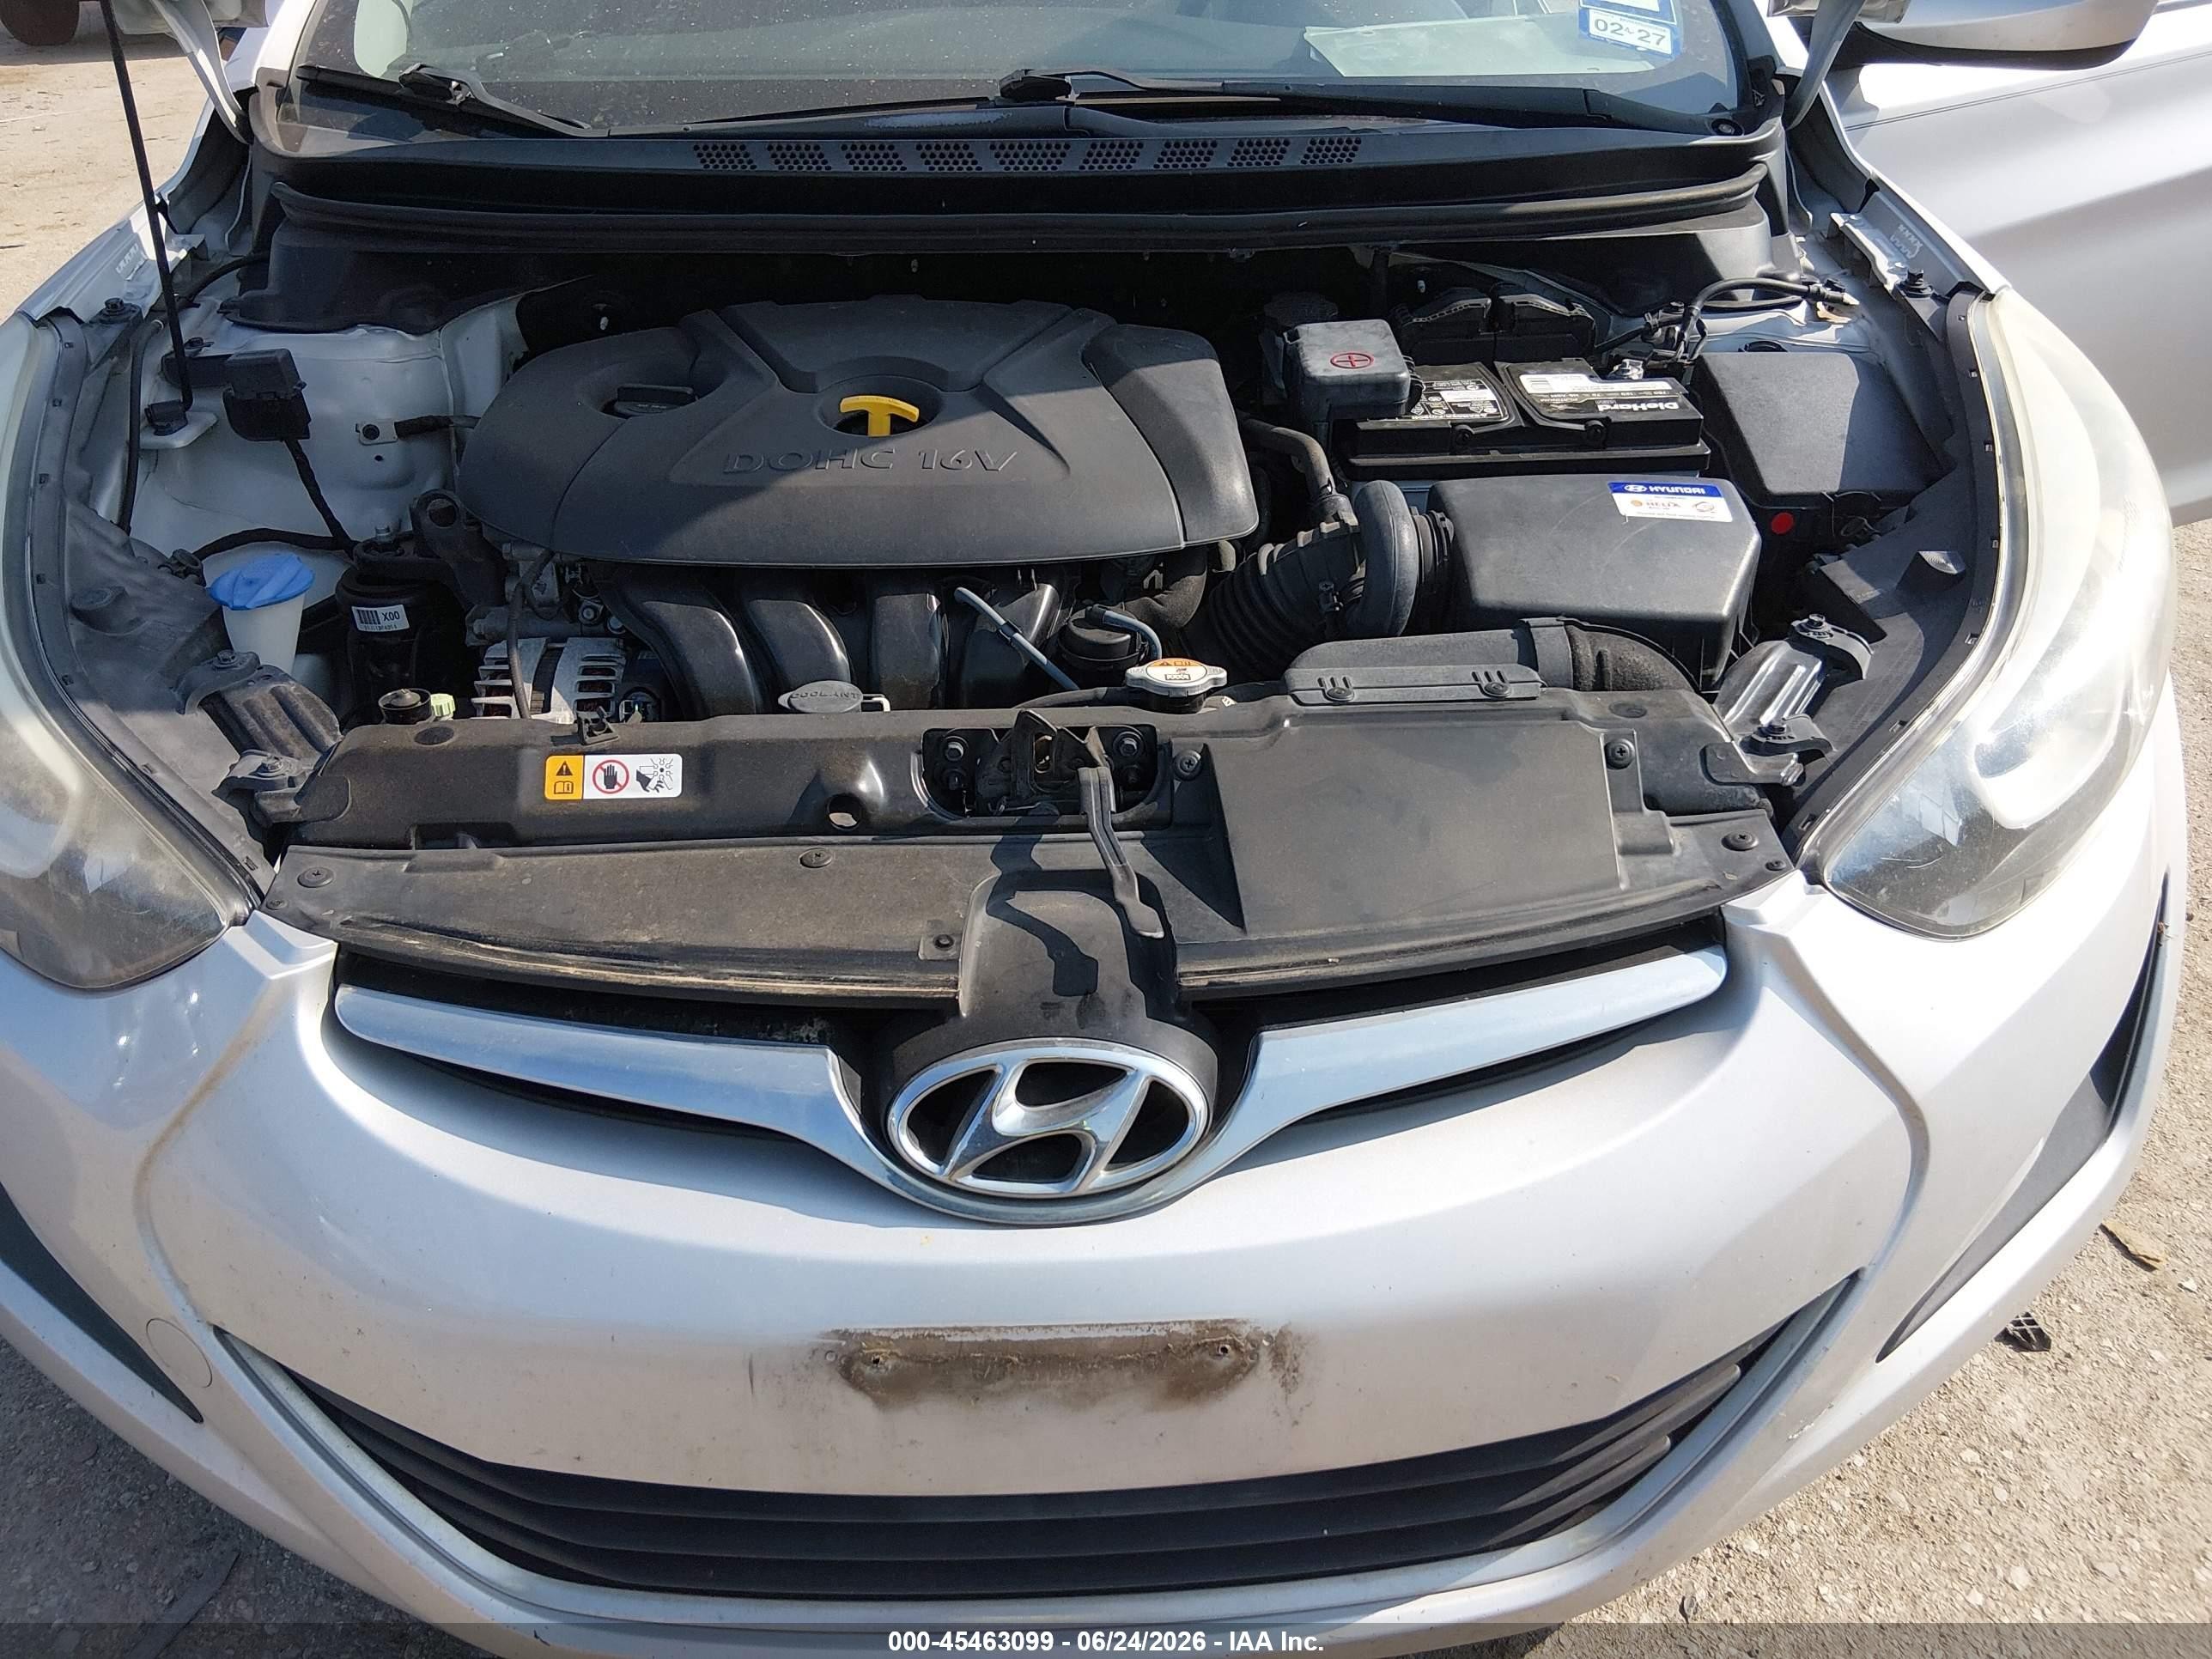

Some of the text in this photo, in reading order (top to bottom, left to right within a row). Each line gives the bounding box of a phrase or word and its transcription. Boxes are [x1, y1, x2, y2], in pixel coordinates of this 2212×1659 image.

[1596, 401, 1680, 412] DieHard
[723, 448, 1018, 473] DOHC 16V
[1649, 484, 1706, 495] HYUNDAI
